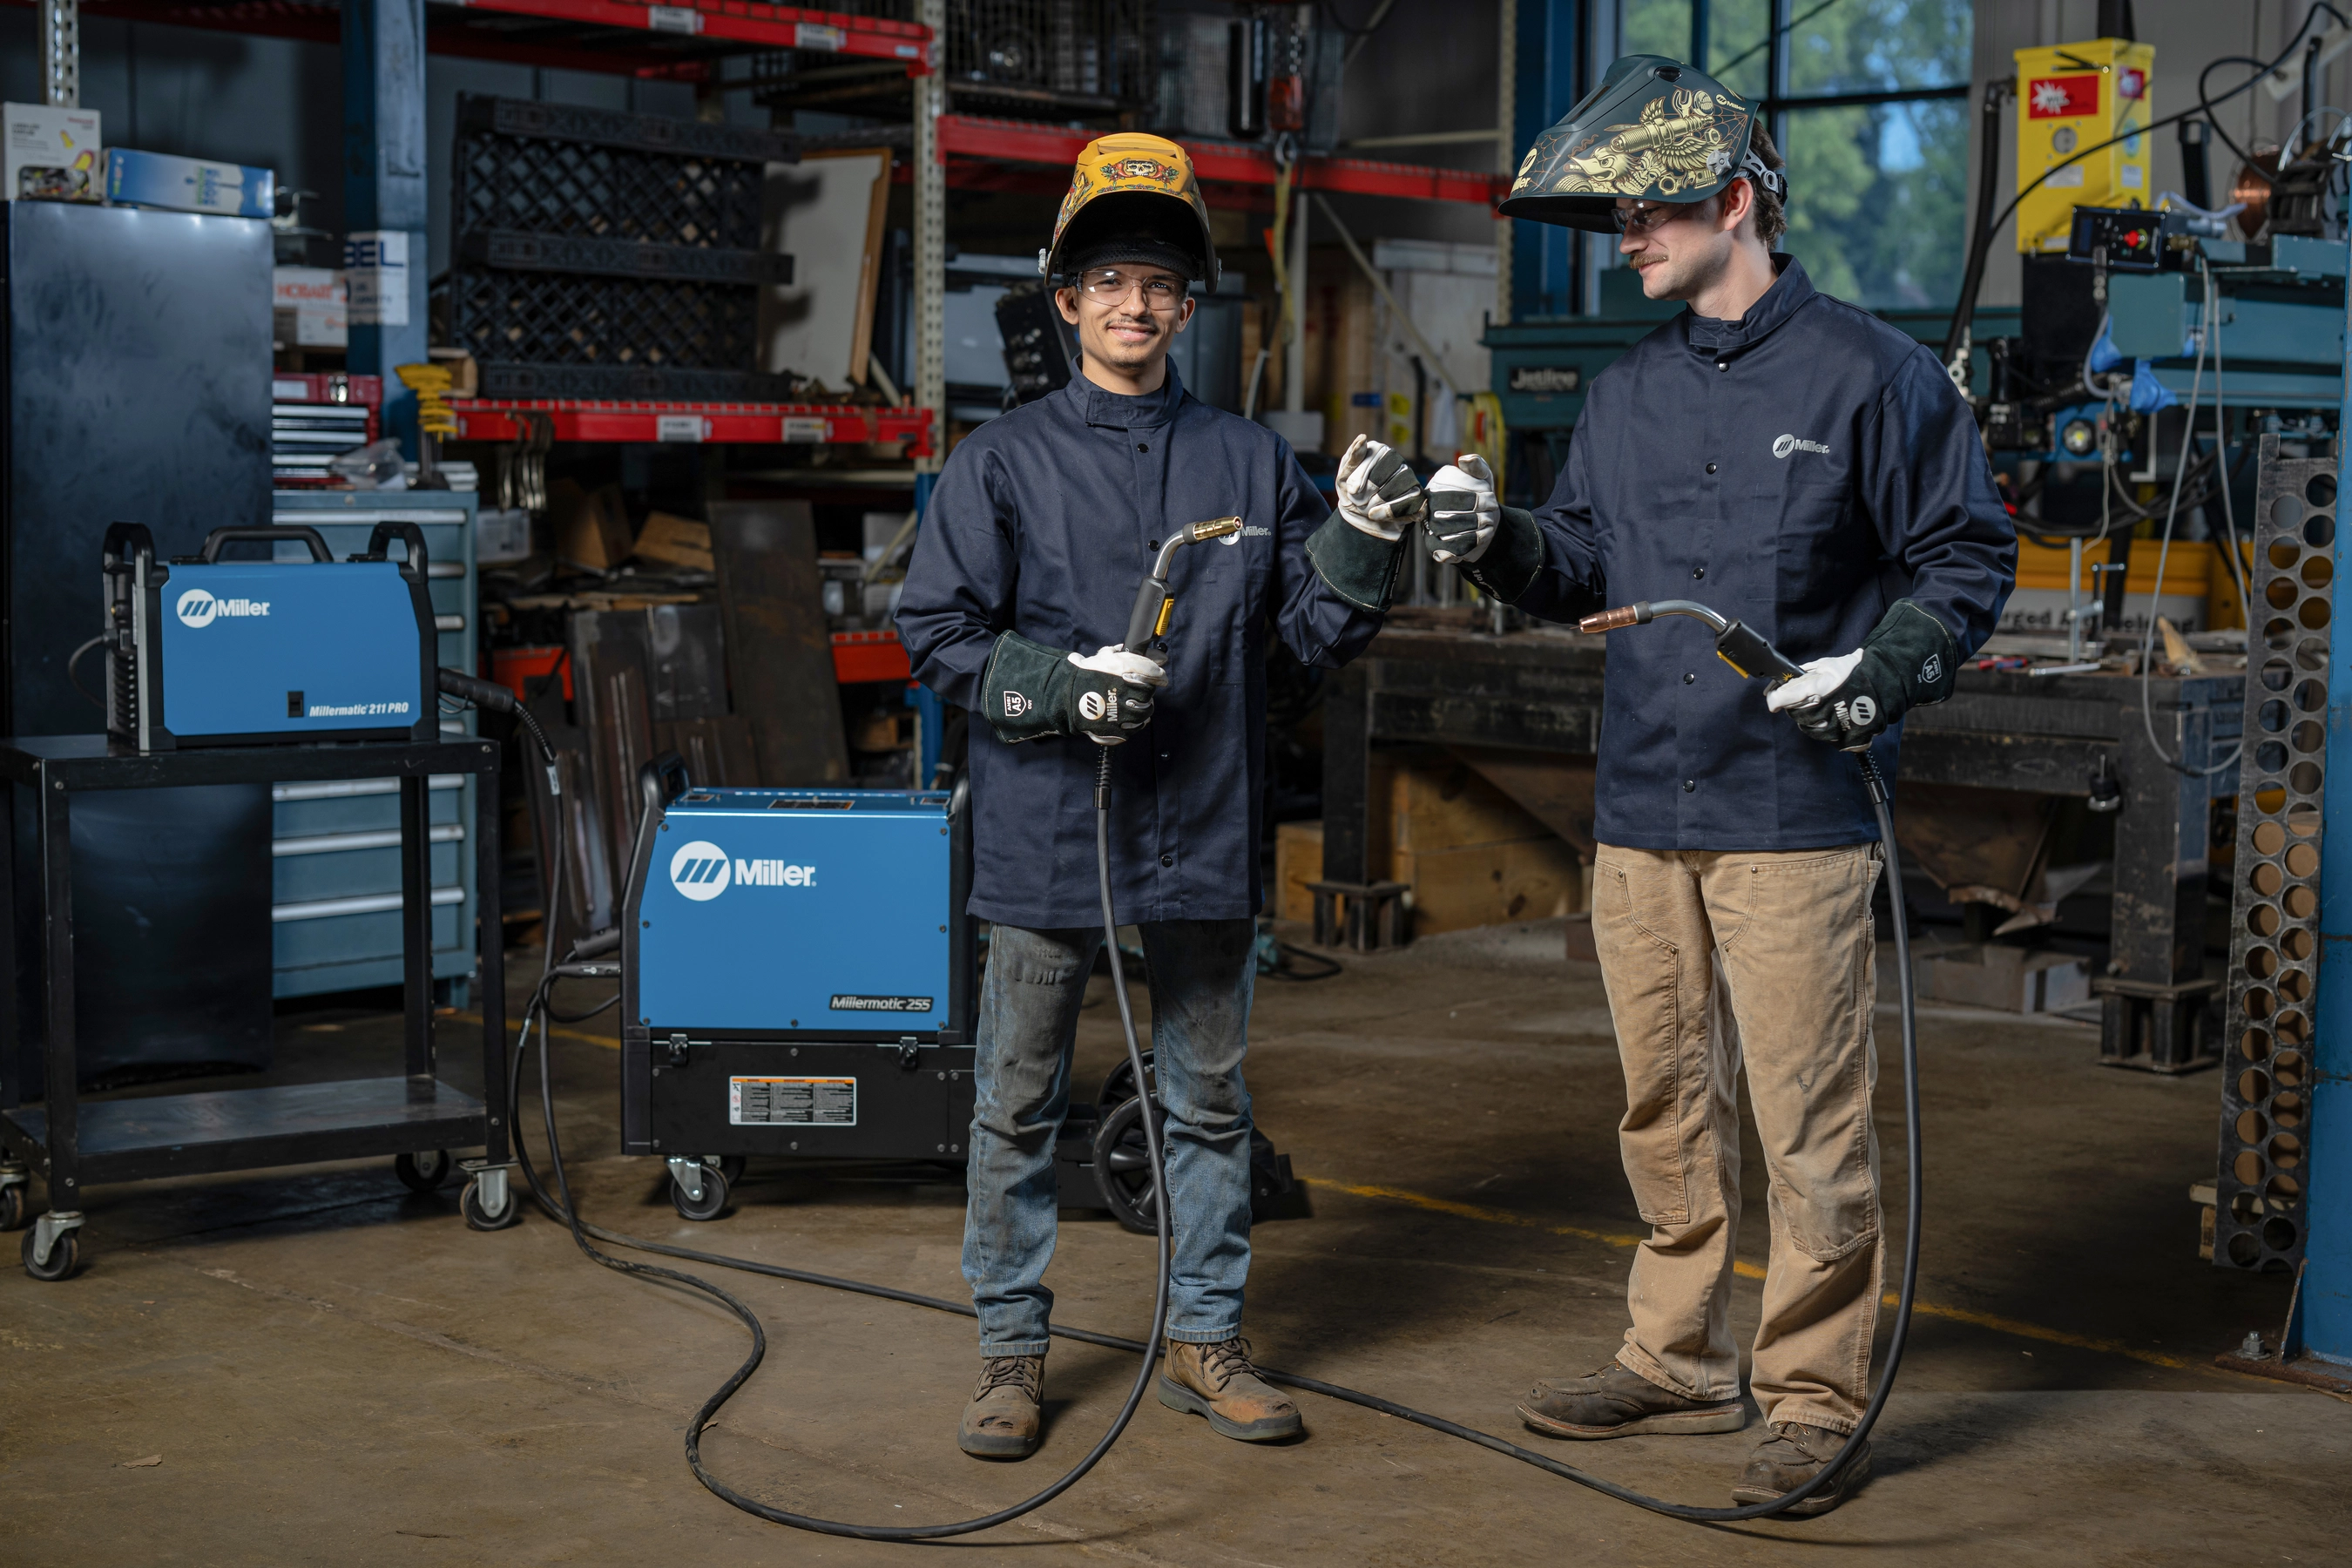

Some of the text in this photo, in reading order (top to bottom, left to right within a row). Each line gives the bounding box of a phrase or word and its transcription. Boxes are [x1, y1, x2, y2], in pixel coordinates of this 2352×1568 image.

[1794, 439, 1828, 453] Miller
[1240, 525, 1269, 537] Miller
[218, 598, 270, 617] Miller
[1924, 665, 1936, 679] A5
[309, 701, 409, 717] Millermatic 211 PRO
[1011, 697, 1022, 712] A5
[1106, 689, 1118, 722] Miller
[1834, 700, 1851, 730] Miller
[735, 859, 815, 887] Miller
[831, 996, 932, 1010] Millermatic 255
